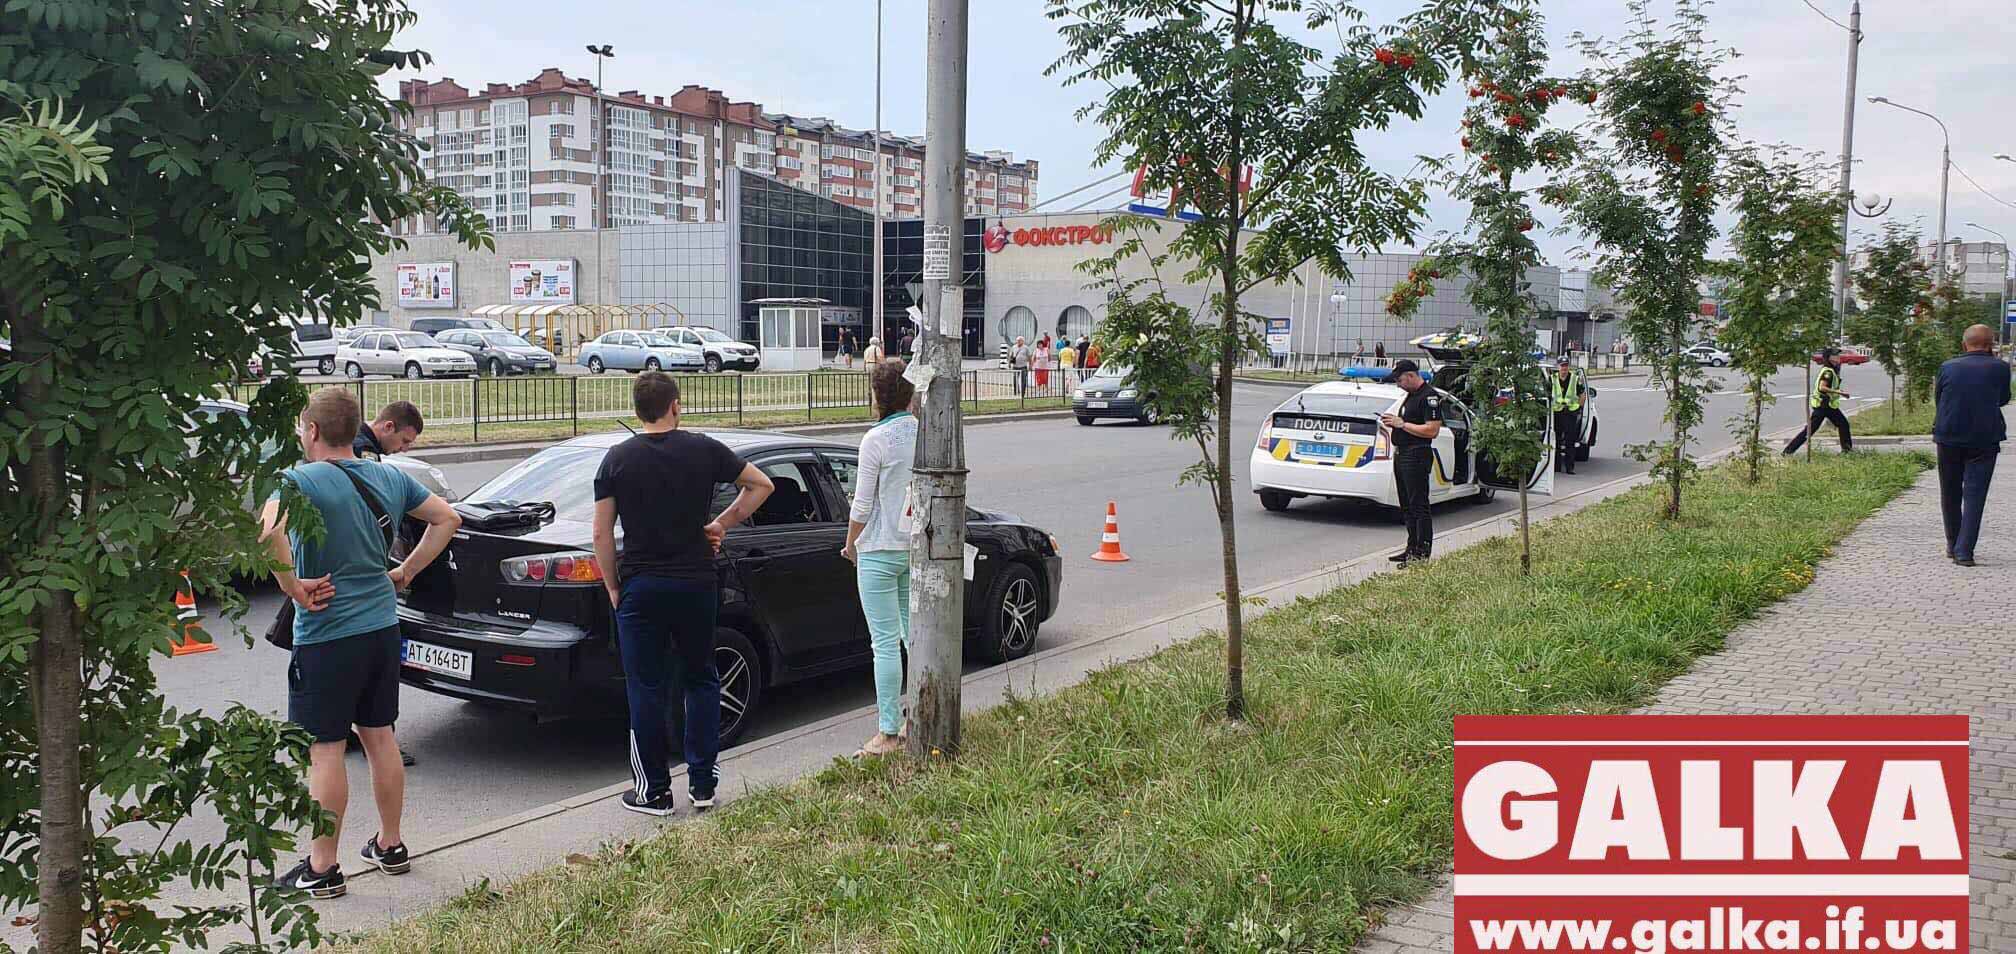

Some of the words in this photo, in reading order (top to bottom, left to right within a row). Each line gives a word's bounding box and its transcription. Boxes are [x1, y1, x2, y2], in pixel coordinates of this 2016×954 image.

[1013, 224, 1114, 247] ФОКСТРОТ
[1294, 418, 1350, 432] ПОЛІЦІЯ
[498, 610, 531, 619] LANCER
[408, 643, 423, 661] AT
[425, 647, 450, 669] 6164
[452, 653, 469, 671] BT
